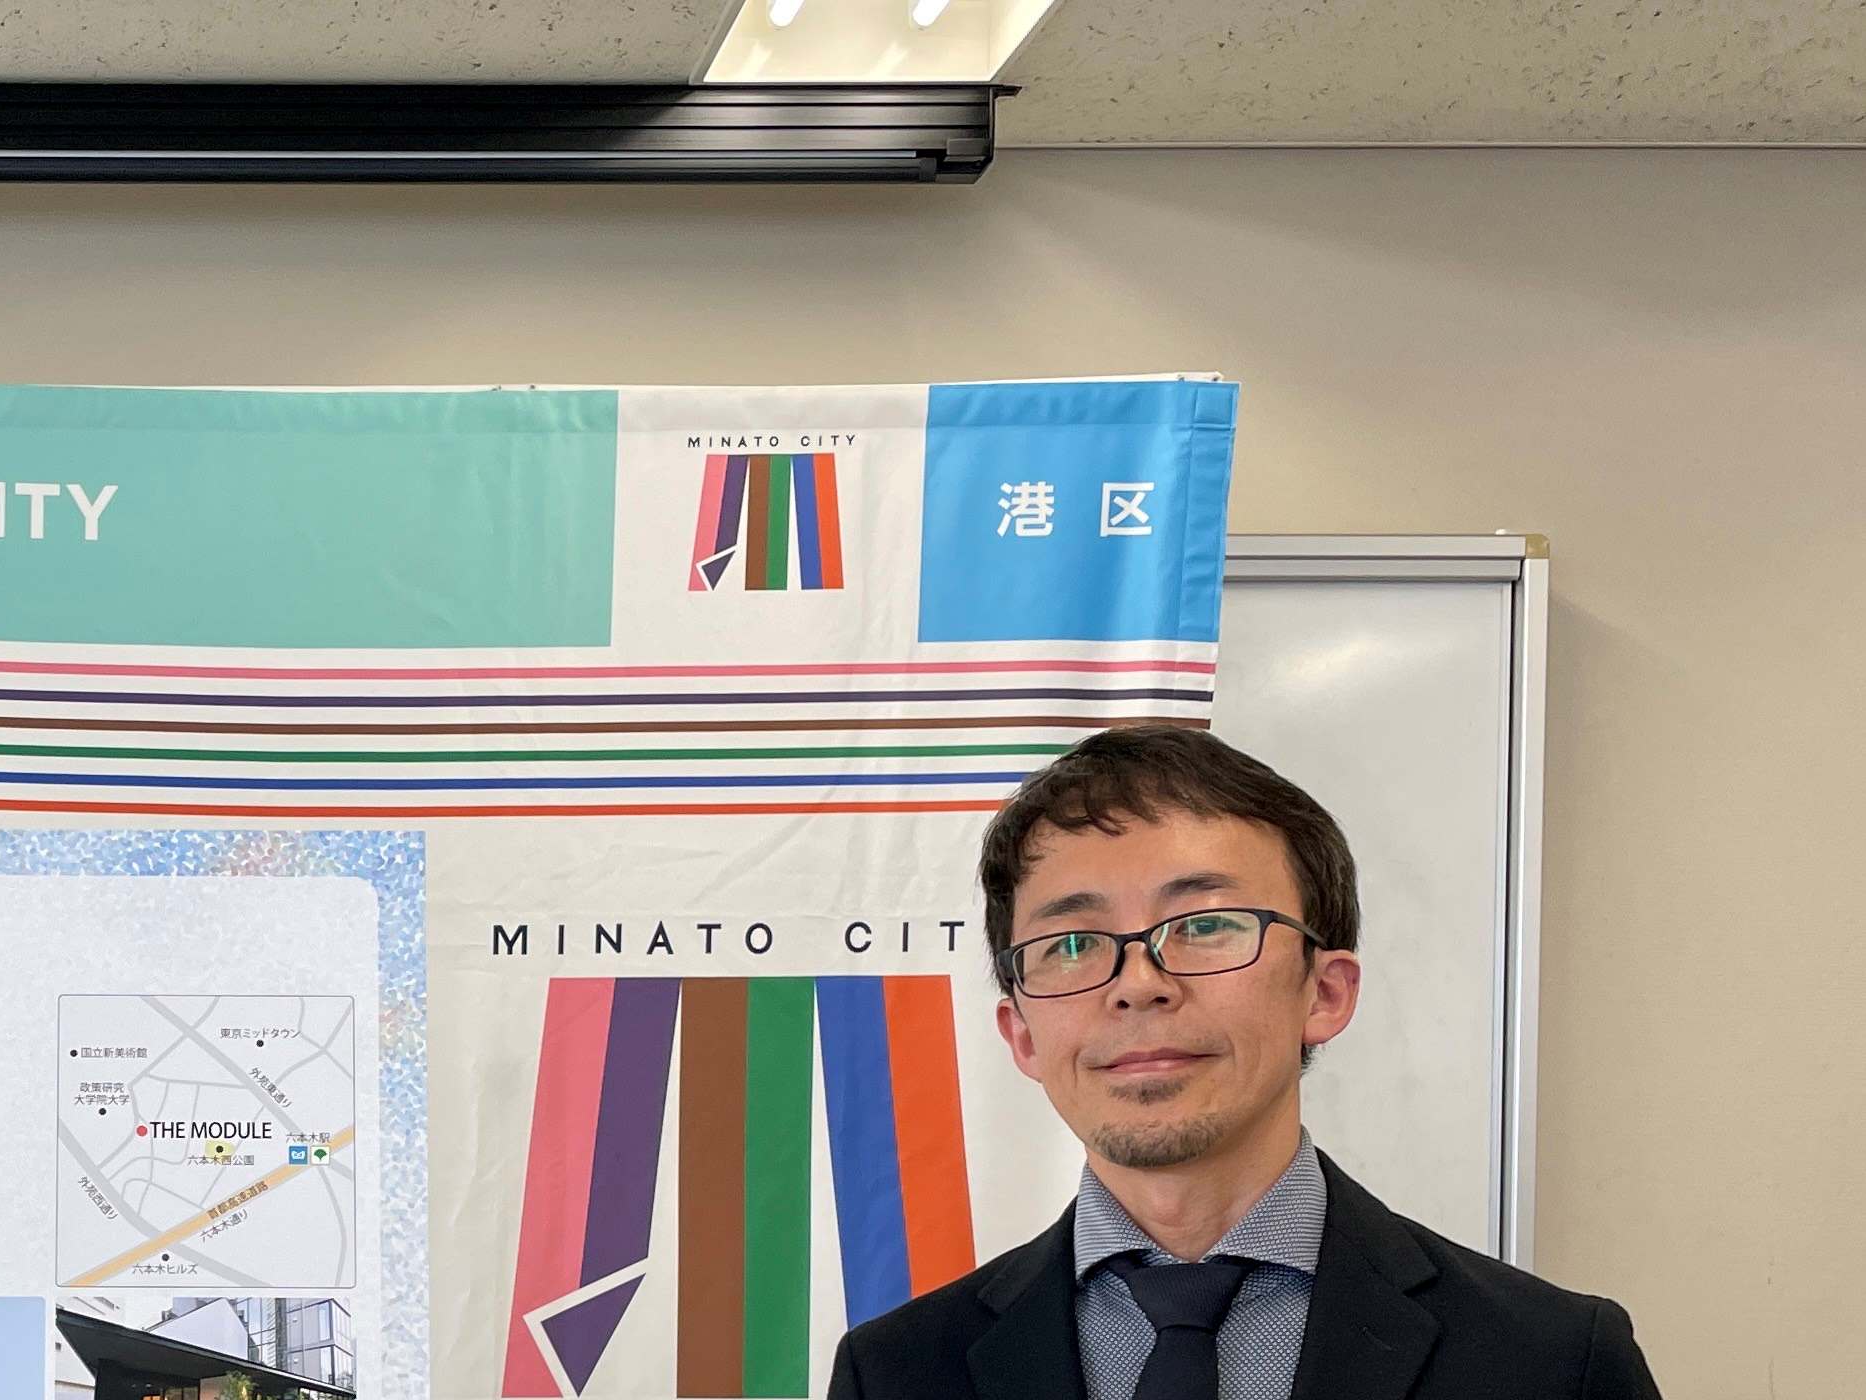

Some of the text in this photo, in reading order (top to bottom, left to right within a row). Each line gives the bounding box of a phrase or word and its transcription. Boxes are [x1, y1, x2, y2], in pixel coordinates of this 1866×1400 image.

[687, 434, 856, 448] MINATO CITY
[492, 920, 965, 955] MINATO CIT
[220, 1027, 301, 1039] 東京ミッドタウン
[150, 1122, 272, 1138] THE MODULE
[132, 1263, 198, 1275] 六本木ヒルズ
